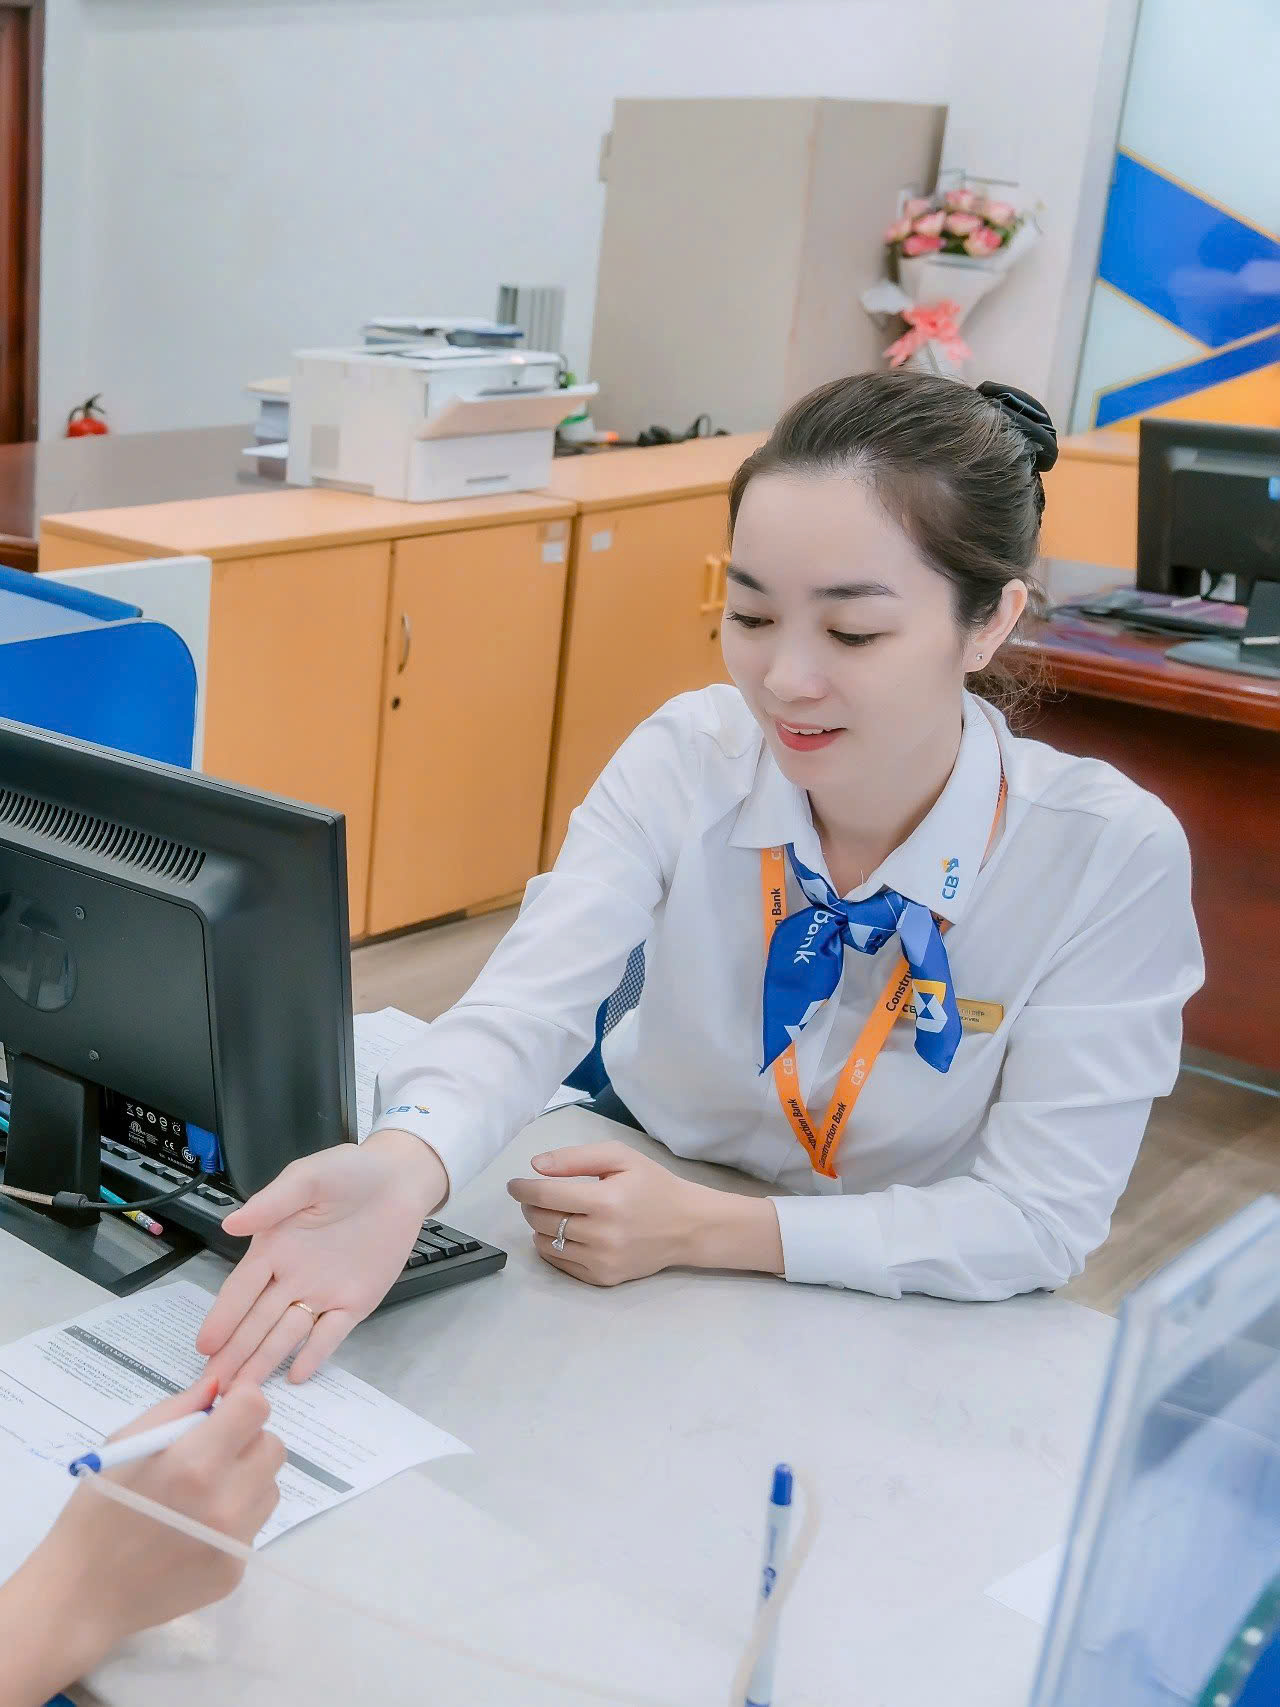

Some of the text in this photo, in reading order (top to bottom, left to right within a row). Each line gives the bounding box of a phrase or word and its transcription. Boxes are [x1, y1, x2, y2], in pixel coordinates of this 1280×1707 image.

[941, 875, 960, 900] CB
[770, 887, 782, 917] Bank
[885, 970, 913, 1012] Constru
[385, 1105, 412, 1116] CB
[832, 1102, 847, 1125] Bank
